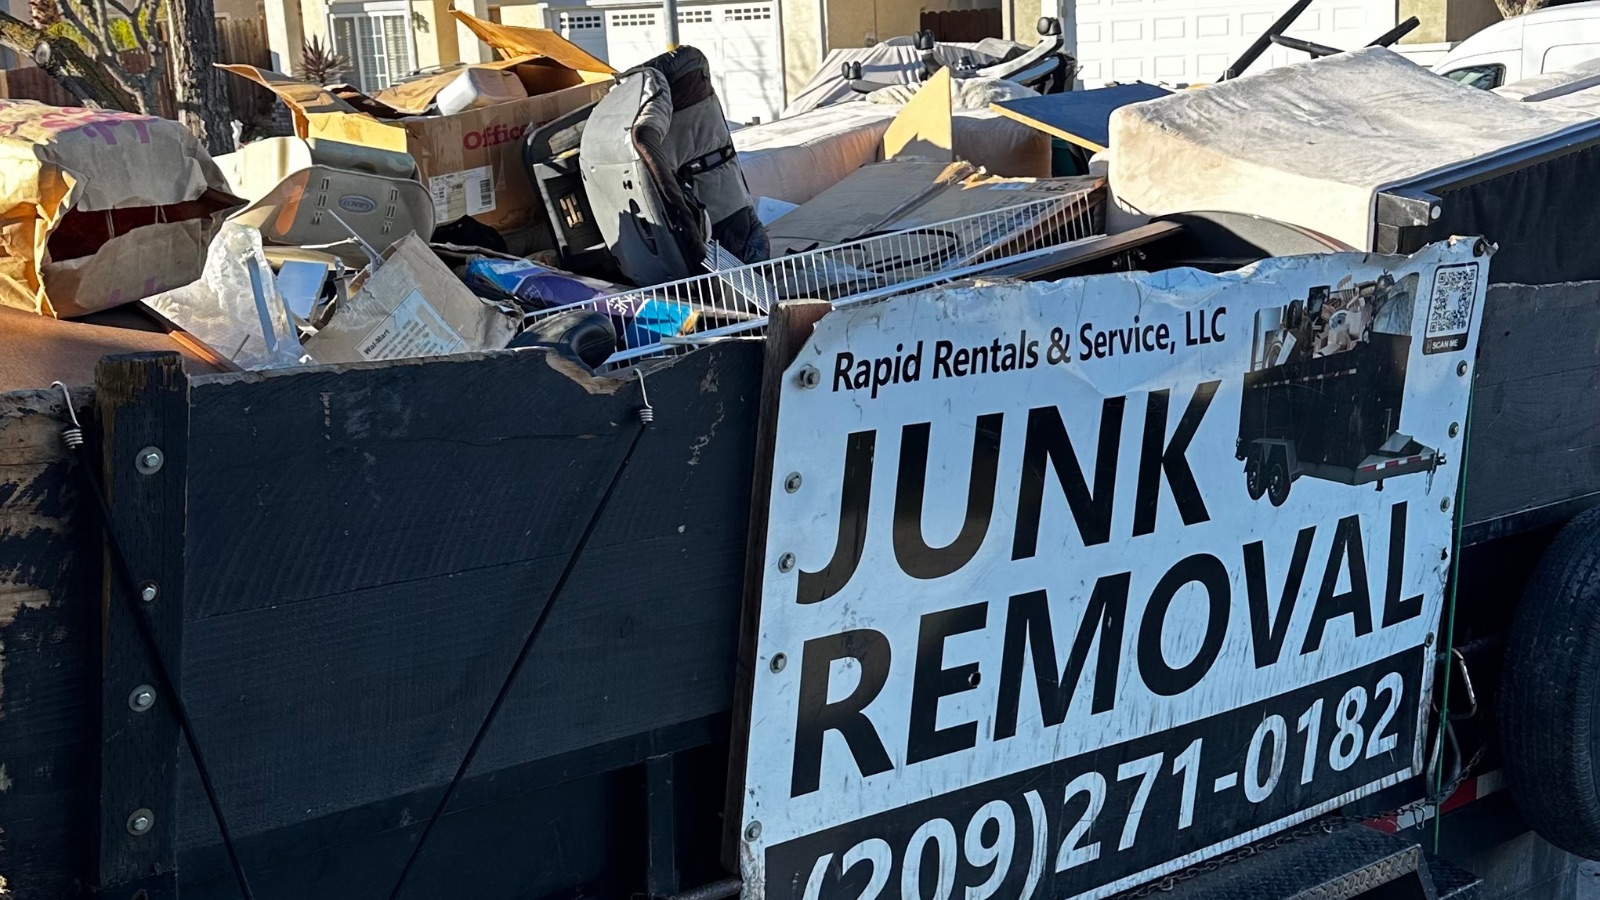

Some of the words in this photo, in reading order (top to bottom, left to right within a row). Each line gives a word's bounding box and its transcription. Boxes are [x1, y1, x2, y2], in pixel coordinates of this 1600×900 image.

[363, 328, 390, 355] Wal-Mart
[832, 341, 923, 399] Rapid
[932, 329, 1039, 379] Rentals
[1046, 326, 1072, 366] &
[1079, 315, 1177, 361] Service,
[1185, 306, 1227, 347] LLC
[1432, 340, 1449, 349] SCAN
[1449, 339, 1458, 347] ME
[796, 379, 1223, 605] JUNK
[790, 501, 1425, 799] REMOVAL
